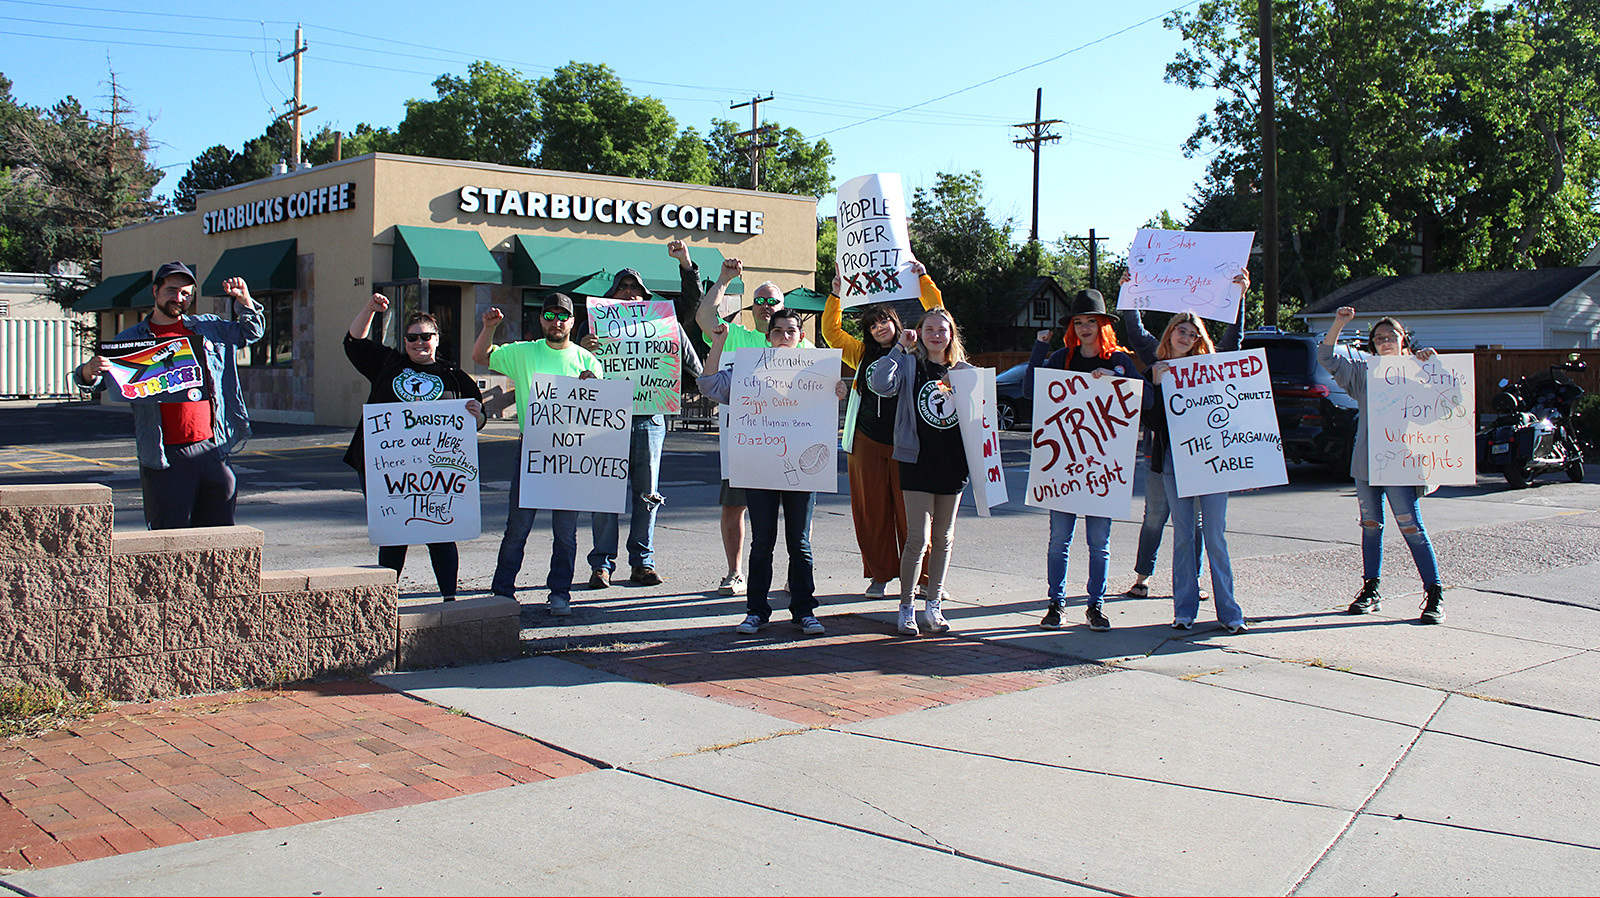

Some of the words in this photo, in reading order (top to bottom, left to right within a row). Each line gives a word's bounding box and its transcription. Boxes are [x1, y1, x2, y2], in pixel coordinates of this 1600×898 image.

[203, 196, 284, 235] STARBUCKS
[287, 182, 351, 219] COFFEE
[459, 185, 652, 227] STARBUCKS
[660, 203, 765, 235] COFFEE
[839, 197, 891, 228] PEOPLE
[846, 225, 890, 247] OVER
[842, 248, 903, 273] PROFIT
[1154, 253, 1177, 265] For
[596, 303, 620, 319] SAY
[629, 305, 646, 318] IT
[595, 341, 621, 356] SAY
[625, 341, 640, 355] IT
[122, 365, 202, 398] STRIKE!
[640, 374, 678, 389] UNION
[1169, 355, 1263, 390] WANTED
[1420, 364, 1467, 388] Strike
[567, 388, 599, 401] ARE
[743, 375, 762, 398] City
[764, 375, 794, 390] Brew
[797, 378, 825, 391] Coffee
[772, 397, 799, 408] Coffee
[920, 399, 941, 425] WORKERS
[1401, 394, 1432, 419] for
[367, 411, 392, 434] If
[529, 402, 627, 431] PARTNERS
[738, 413, 757, 427] The
[761, 416, 790, 428] Human
[1033, 379, 1139, 472] STRIKE
[1207, 406, 1230, 429] @
[380, 438, 406, 449] are
[411, 431, 432, 447] out
[552, 433, 586, 448] NOT
[737, 432, 787, 458] Dazbog
[1385, 427, 1450, 445] Workers
[374, 456, 406, 471] there
[413, 455, 423, 464] is
[428, 454, 478, 481] something
[527, 450, 629, 480] EMPLOYEES
[1397, 448, 1464, 481] Rights
[384, 470, 467, 495] WRONG
[1086, 459, 1127, 497] fight
[380, 506, 397, 517] in
